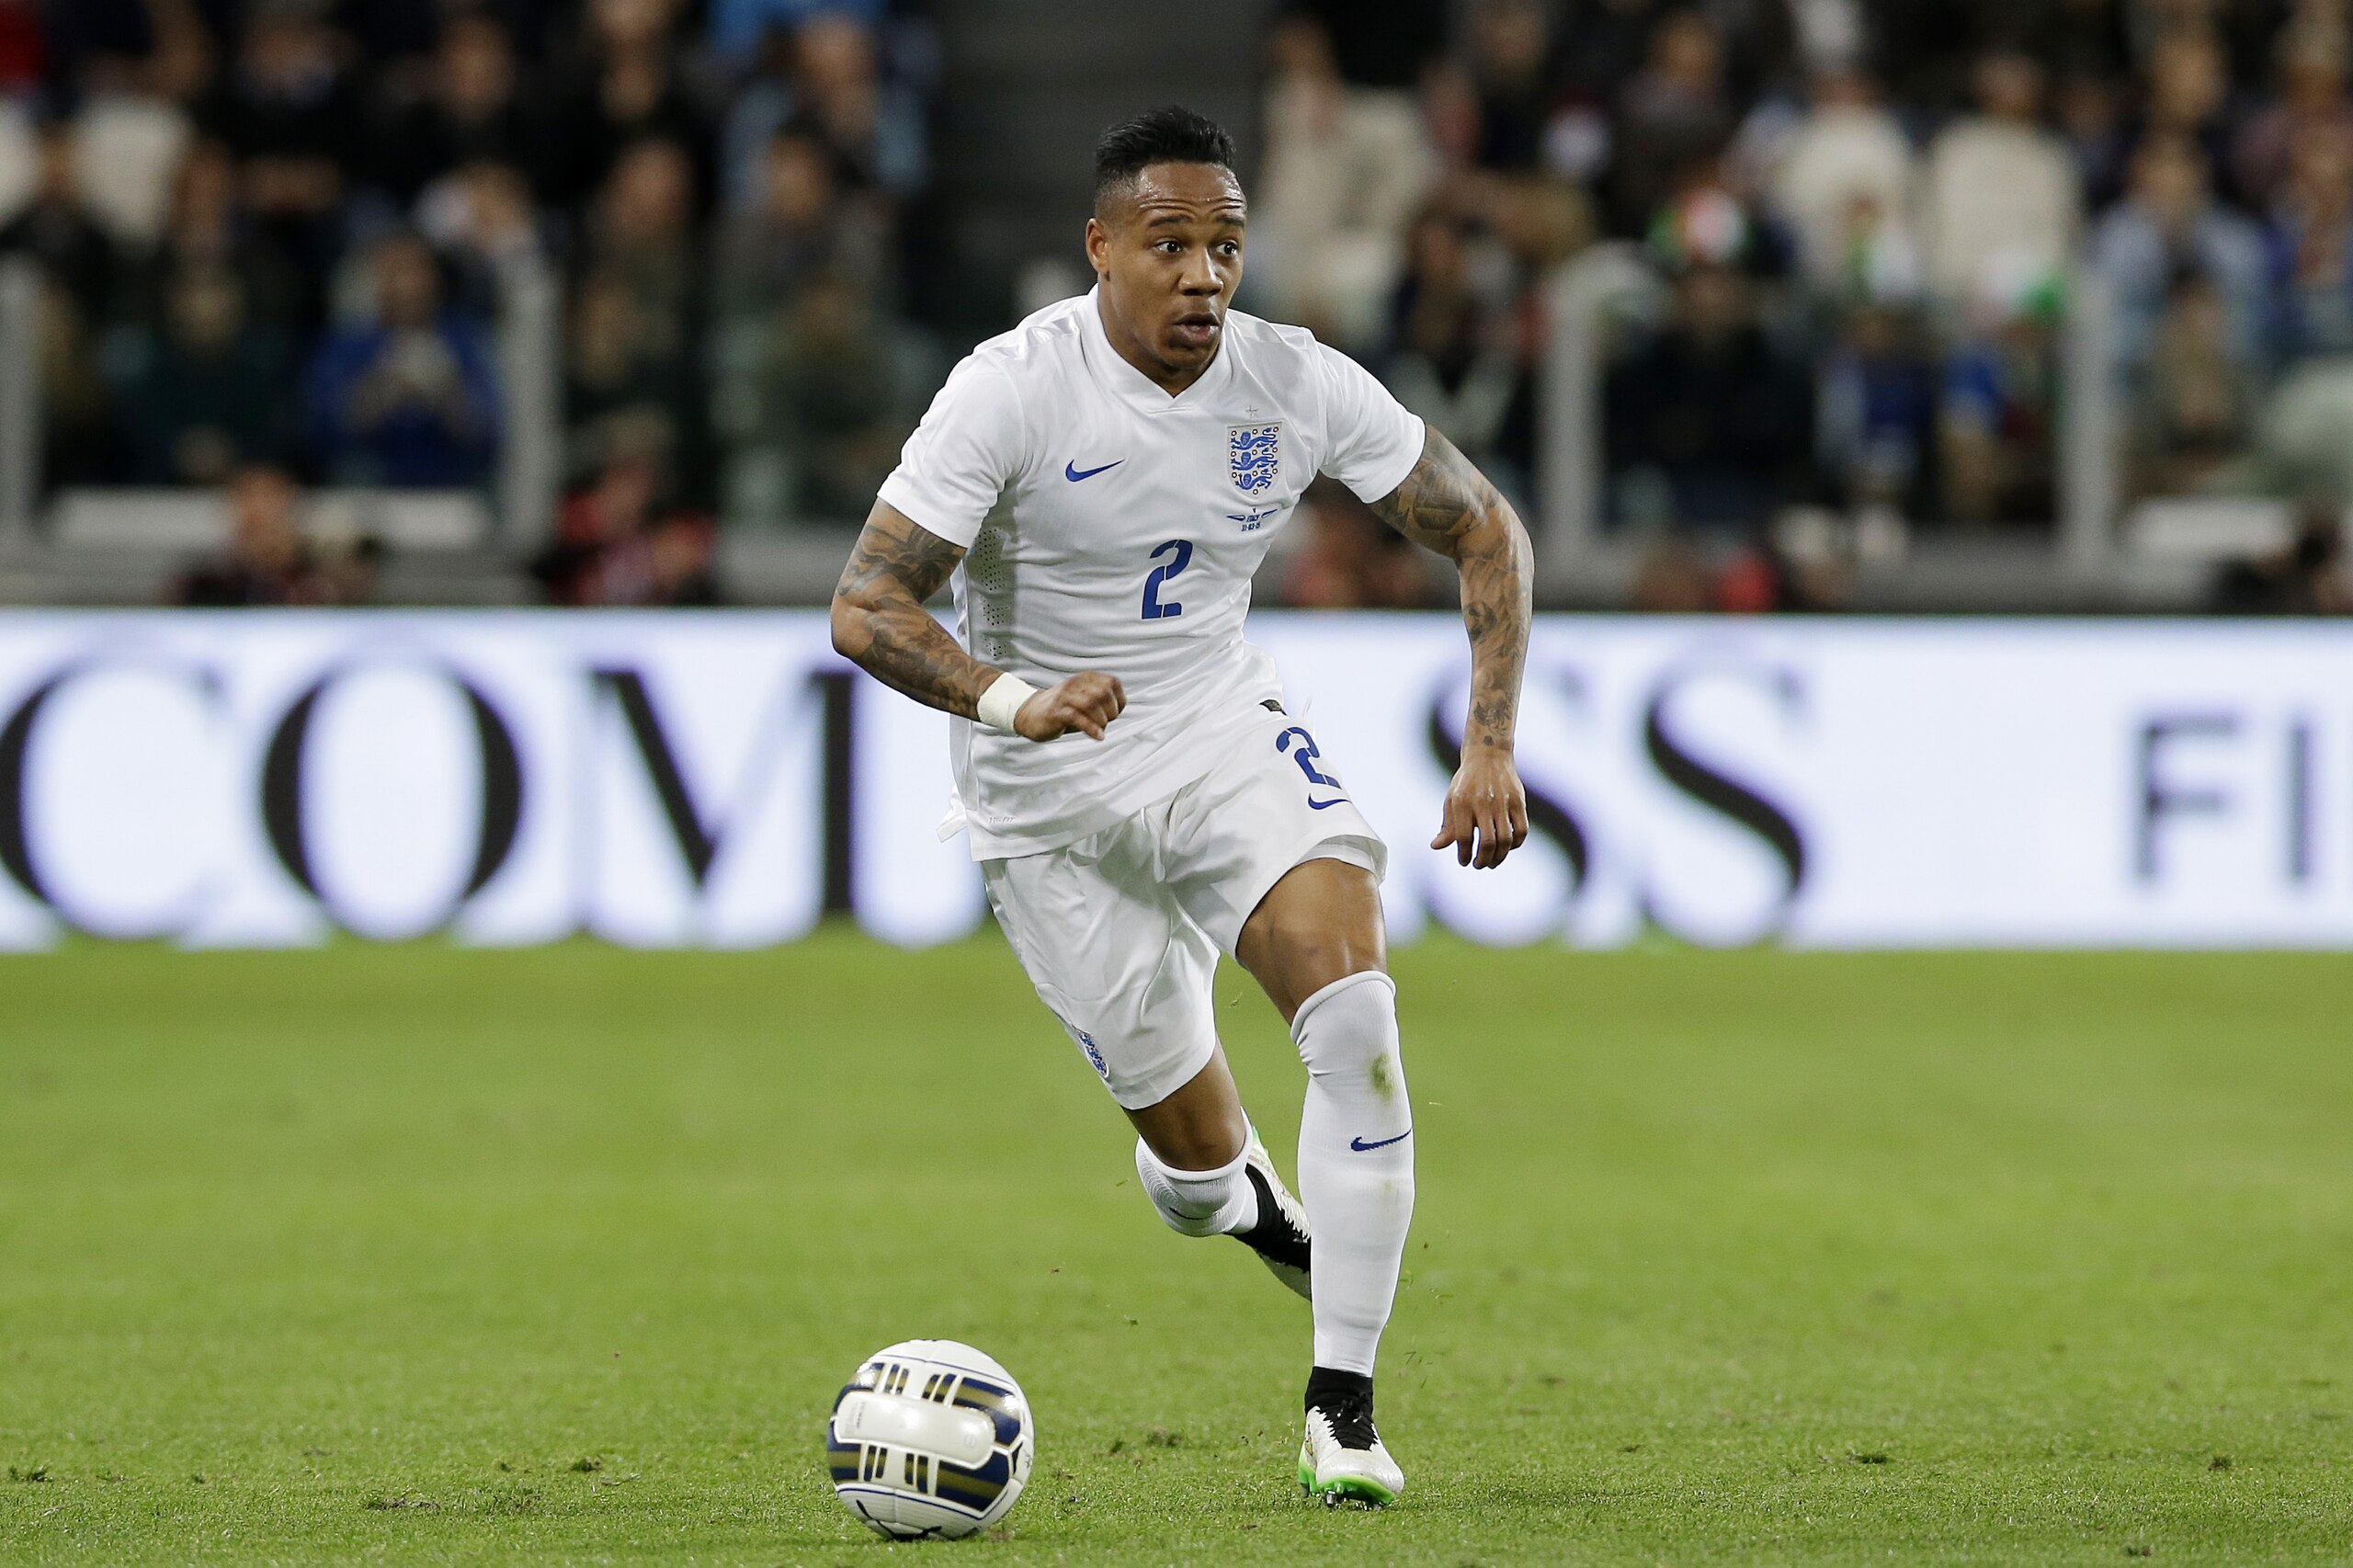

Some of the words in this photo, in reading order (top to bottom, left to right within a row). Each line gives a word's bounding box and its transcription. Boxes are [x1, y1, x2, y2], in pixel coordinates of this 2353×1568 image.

[1142, 539, 1193, 620] 2
[0, 649, 1813, 943] COMSS
[1276, 726, 1342, 790] 2
